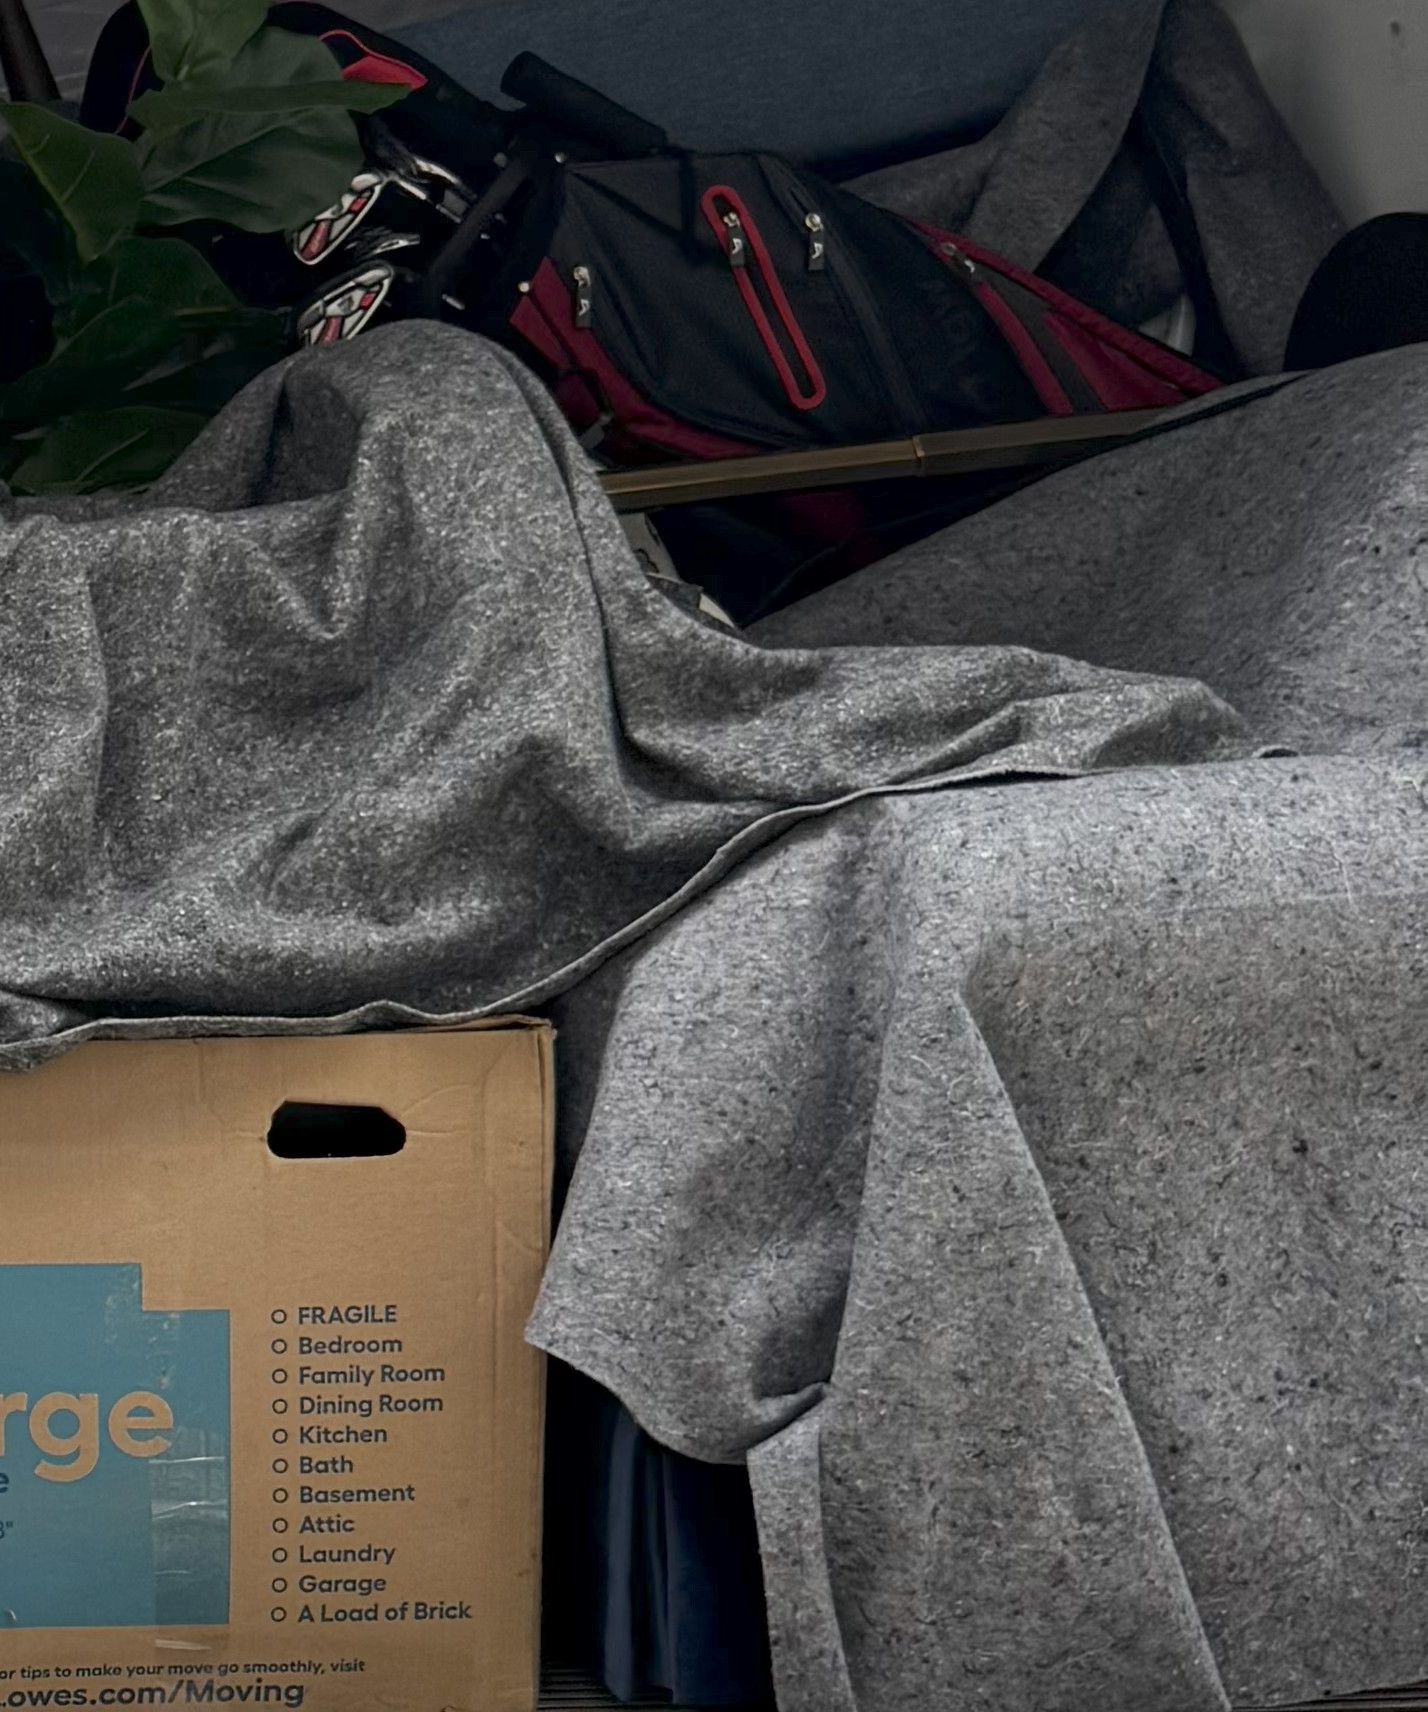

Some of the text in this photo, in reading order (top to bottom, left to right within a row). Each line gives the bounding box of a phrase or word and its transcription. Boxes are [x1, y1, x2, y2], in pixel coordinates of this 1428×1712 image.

[298, 1303, 398, 1325] FRAGILE
[299, 1334, 403, 1355] Bedroom
[299, 1364, 446, 1388] Family Room
[299, 1393, 444, 1417] Dining Room
[299, 1424, 388, 1444] Kitchen
[299, 1454, 354, 1474] Bath
[299, 1483, 415, 1504] Basement
[299, 1514, 355, 1534] Attic
[299, 1544, 396, 1567] Laundry
[299, 1574, 387, 1597] Garage
[298, 1600, 472, 1623] A Load of Brick
[20, 1665, 50, 1682] tips
[54, 1667, 69, 1679] to
[74, 1665, 121, 1679] make
[125, 1667, 163, 1682] your
[167, 1666, 212, 1677] move
[217, 1666, 238, 1679] go
[242, 1660, 327, 1677] smoothly,
[330, 1659, 366, 1672] visit
